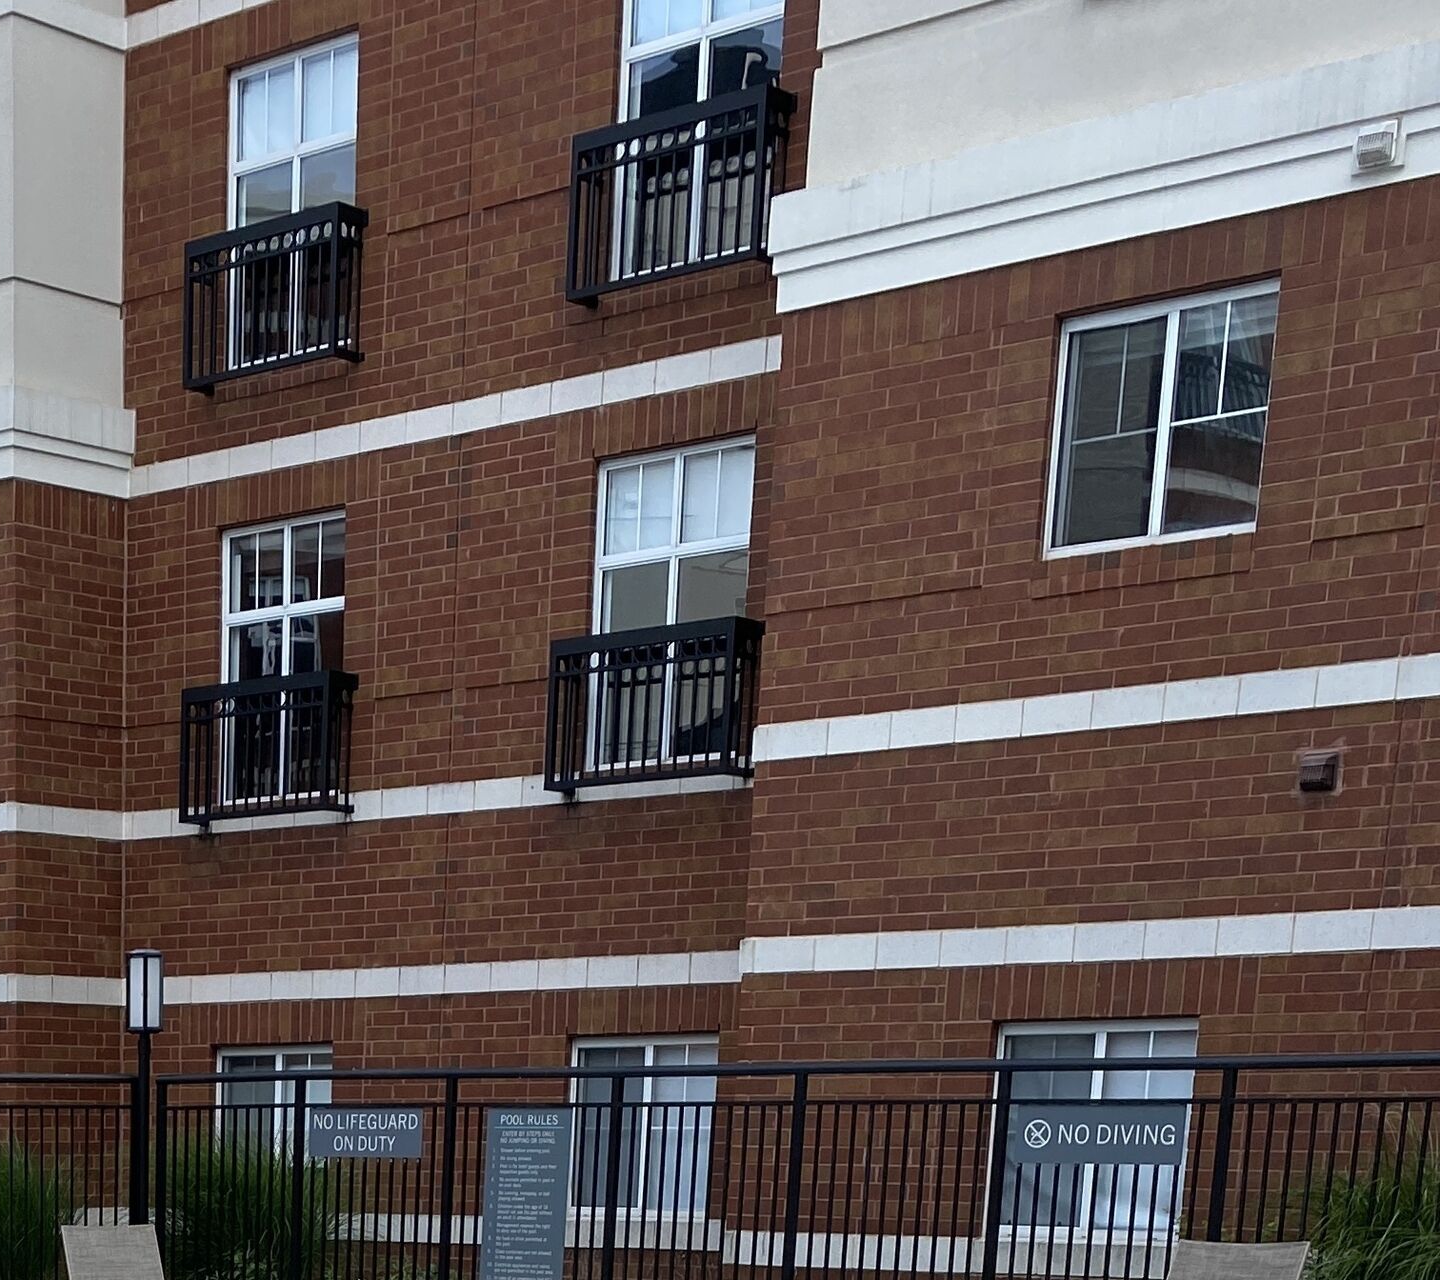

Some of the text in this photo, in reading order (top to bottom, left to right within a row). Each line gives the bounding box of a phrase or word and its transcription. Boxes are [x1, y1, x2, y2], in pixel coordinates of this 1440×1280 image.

[313, 1114, 419, 1130] NO LIFEGUARD
[500, 1114, 559, 1126] POOL RULES
[1057, 1123, 1176, 1145] NO DIVING
[333, 1135, 396, 1152] ON DUTY
